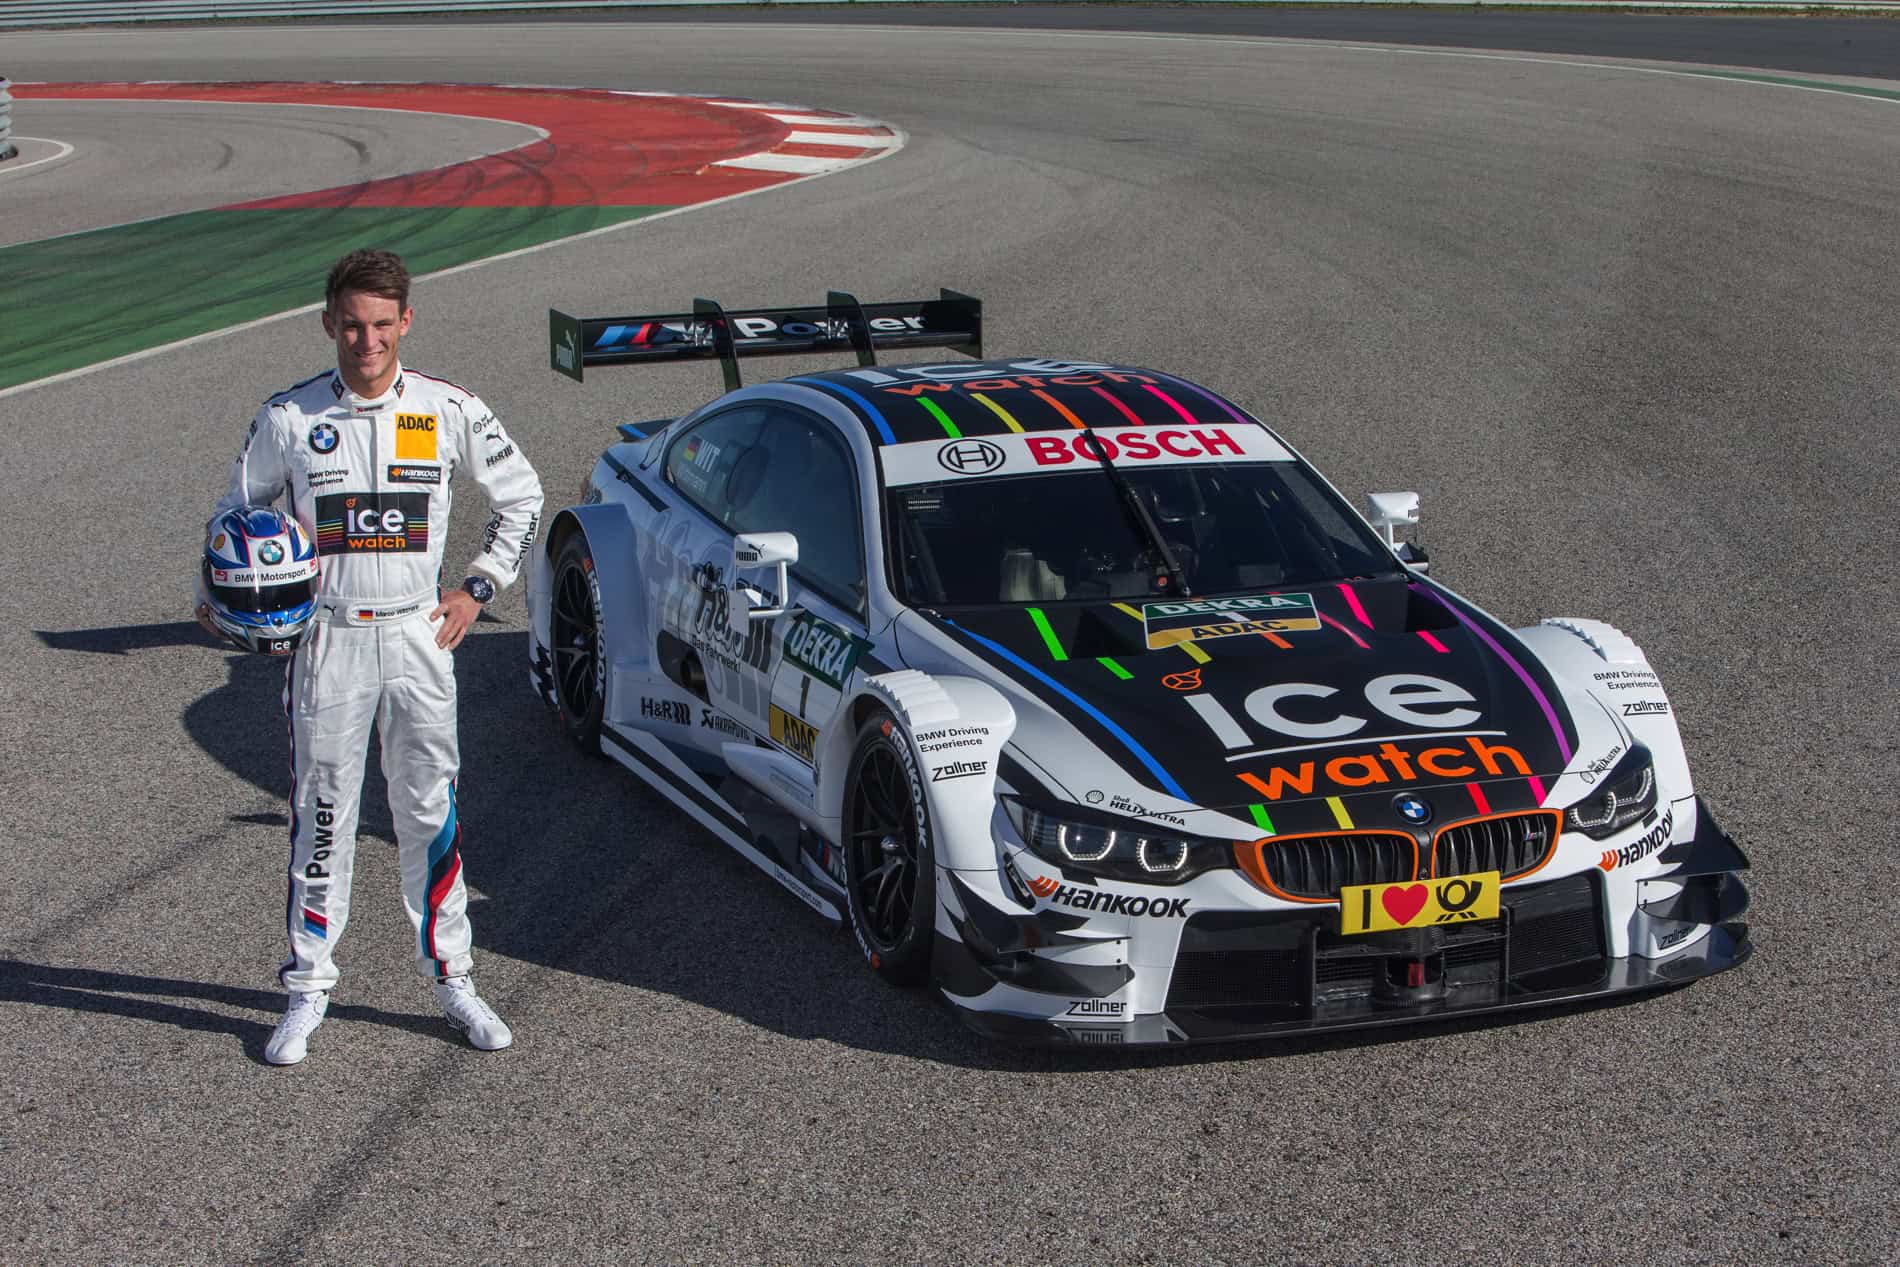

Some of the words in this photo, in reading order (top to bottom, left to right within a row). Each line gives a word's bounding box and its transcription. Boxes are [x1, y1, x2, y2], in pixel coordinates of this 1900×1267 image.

[882, 370, 1153, 396] watch
[397, 415, 434, 432] ADAC
[1024, 429, 1246, 466] BOSCH
[324, 468, 349, 478] Driving
[347, 508, 405, 533] ice
[348, 536, 406, 549] watch
[260, 568, 307, 582] Motorsport
[1154, 597, 1305, 615] DEKRA
[1191, 621, 1289, 639] ADAC
[789, 619, 853, 681] DEKRA
[1593, 671, 1620, 681] BMW
[1621, 670, 1656, 680] Driving
[1607, 681, 1659, 690] Experience
[1183, 674, 1483, 750] ice
[916, 730, 947, 743] BMW
[948, 726, 990, 738] Driving
[920, 737, 984, 753] Experience
[1236, 736, 1535, 801] watch
[305, 797, 335, 879] Power
